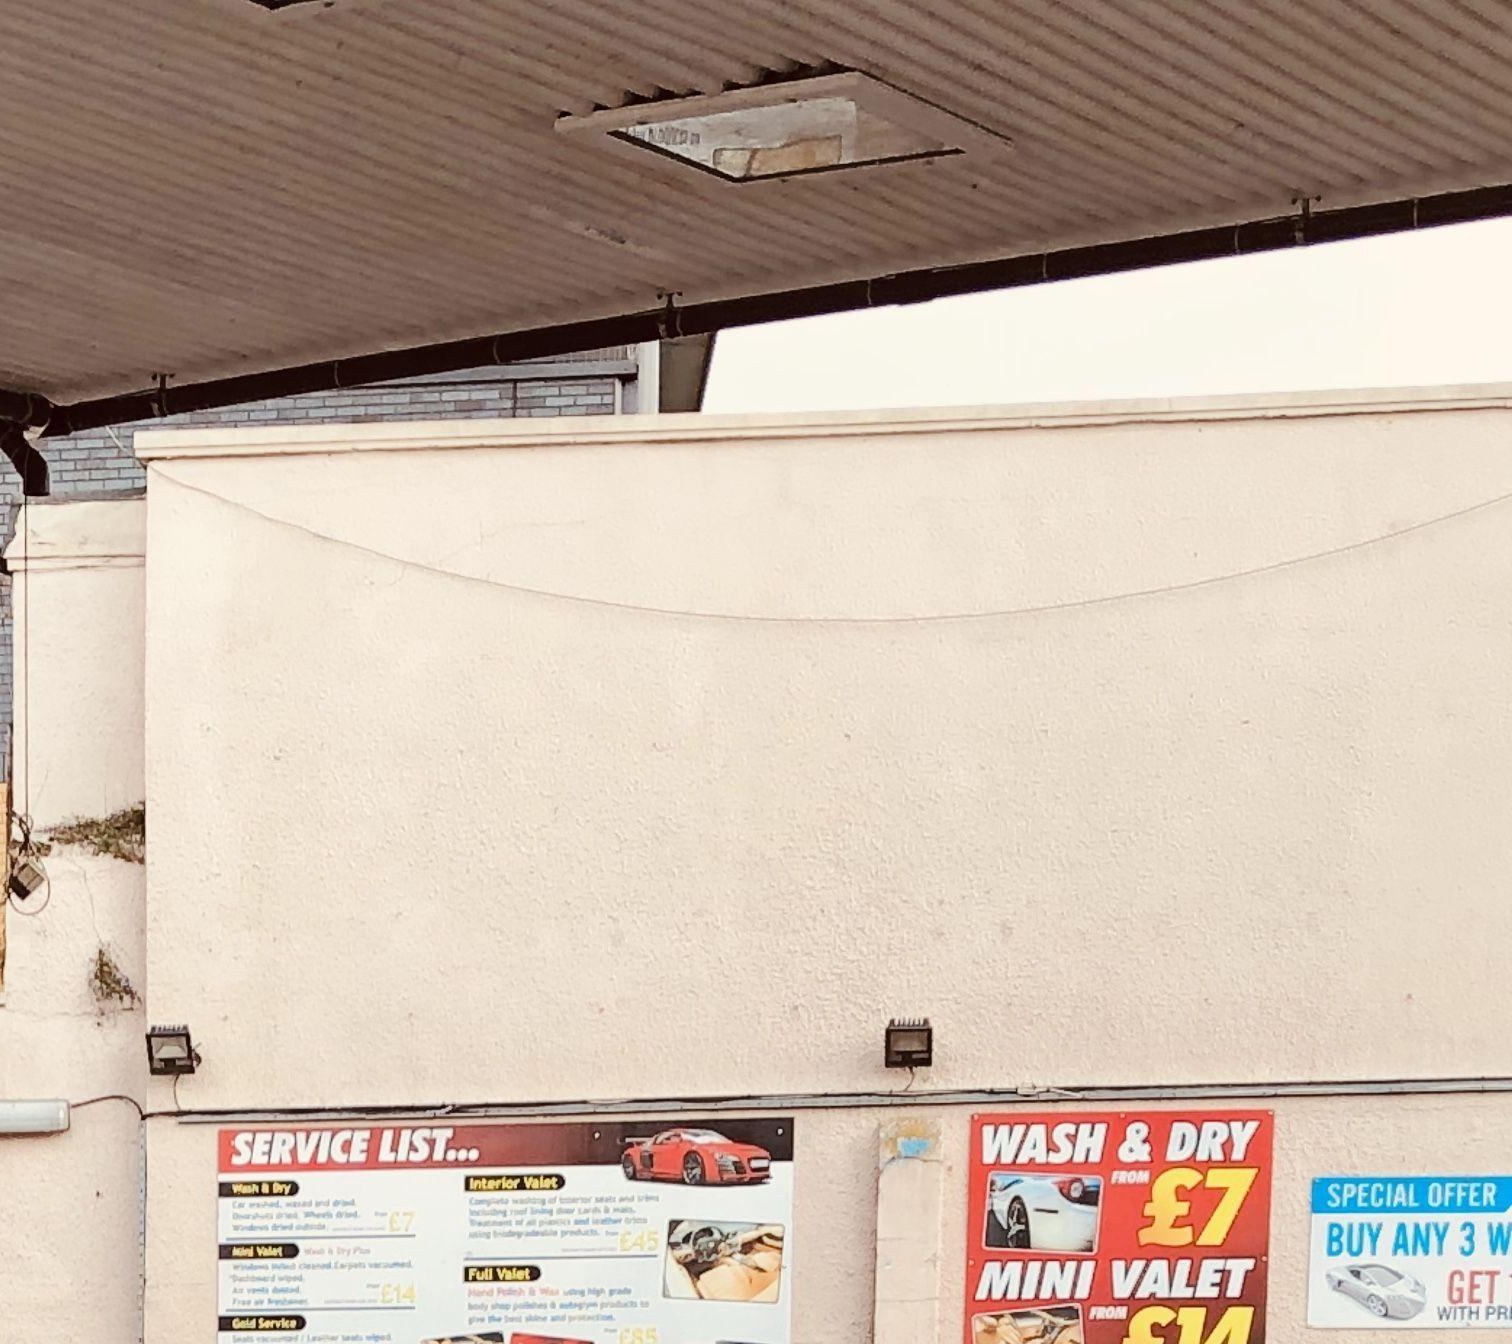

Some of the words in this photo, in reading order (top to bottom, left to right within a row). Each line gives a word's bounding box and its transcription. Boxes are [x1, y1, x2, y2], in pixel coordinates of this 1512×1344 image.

[231, 1128, 371, 1165] SERVICE
[981, 1122, 1109, 1165] WASH
[1117, 1121, 1153, 1163] &
[1165, 1120, 1260, 1162] DRY
[232, 1182, 259, 1194] Wash
[273, 1182, 292, 1196] Dry
[470, 1176, 520, 1190] Interior
[524, 1176, 558, 1189] Valet
[1327, 1182, 1420, 1208] SPECIAL
[1427, 1182, 1497, 1208] OFFER
[1110, 1170, 1151, 1185] FROM
[1137, 1167, 1259, 1247] £7
[1326, 1222, 1384, 1257] BUY
[1392, 1222, 1450, 1257] ANY
[1460, 1222, 1476, 1257] 3
[468, 1268, 493, 1280] Full
[497, 1268, 531, 1280] Valet
[974, 1259, 1096, 1301] MINI
[1110, 1258, 1256, 1299] VALET
[1448, 1269, 1501, 1305] GET
[232, 1318, 256, 1329] Gold
[259, 1318, 297, 1330] Service
[1089, 1306, 1129, 1321] FROM
[1437, 1306, 1480, 1321] WITH
[1486, 1306, 1512, 1321] PR
